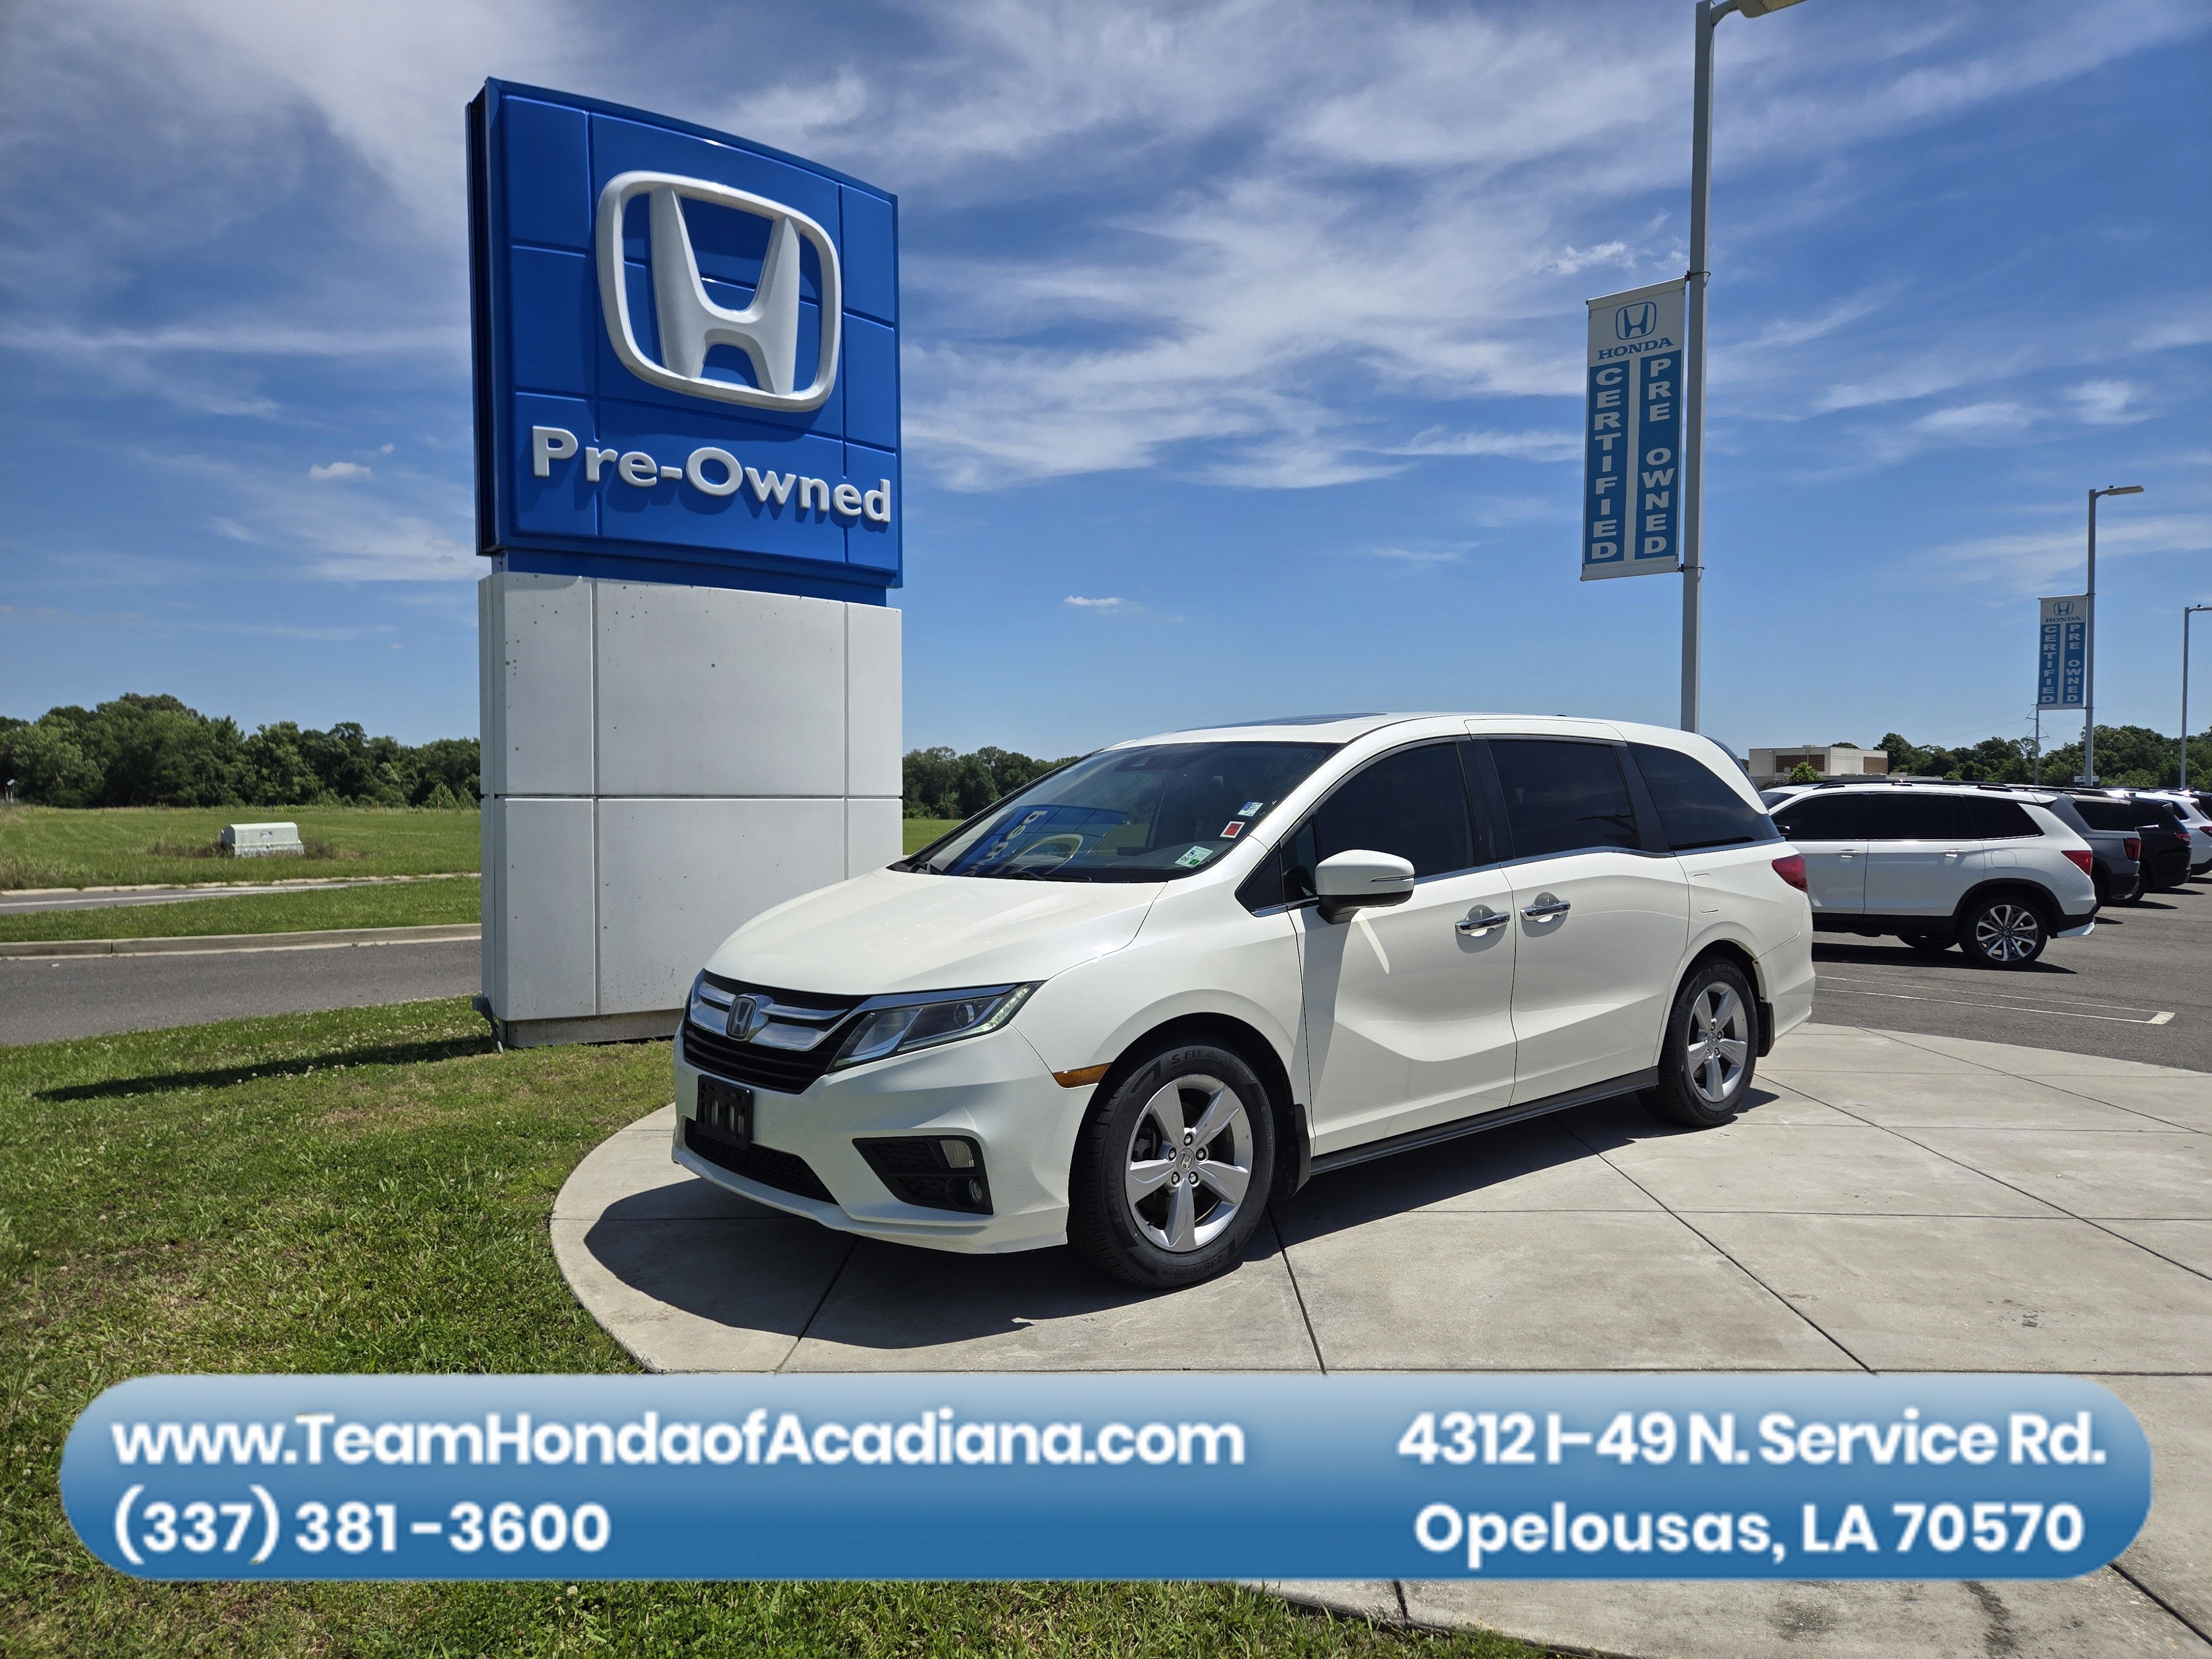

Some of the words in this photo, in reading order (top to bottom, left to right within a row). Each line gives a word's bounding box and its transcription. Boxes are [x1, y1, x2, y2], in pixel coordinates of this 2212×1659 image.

[1598, 337, 1673, 359] HONDA
[1648, 358, 1672, 422] PRE
[533, 426, 891, 523] Pre-Owned
[1591, 368, 1623, 560] CERTIFIED
[1642, 447, 1674, 554] OWNED
[2042, 626, 2057, 702] CERTIFIED
[2069, 624, 2080, 650] PRE
[2066, 659, 2081, 702] OWNED
